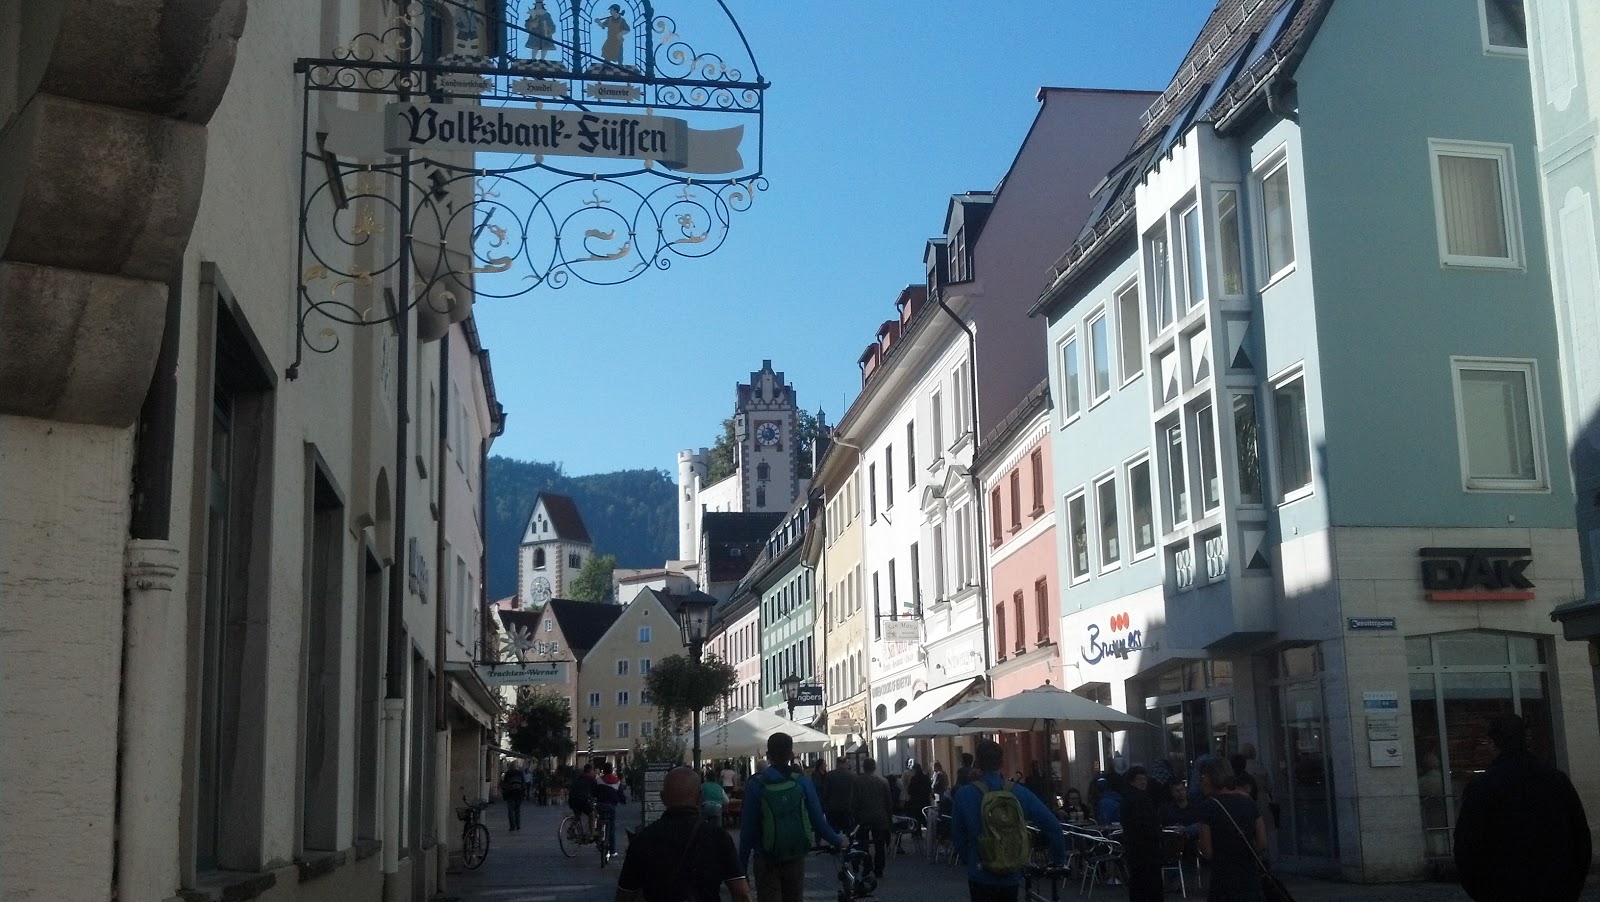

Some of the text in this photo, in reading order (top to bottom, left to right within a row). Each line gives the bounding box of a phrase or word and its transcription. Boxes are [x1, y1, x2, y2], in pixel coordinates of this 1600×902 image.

[527, 83, 553, 92] Handel
[598, 88, 629, 97] Gewerbe
[1421, 556, 1535, 590] DAK
[797, 694, 822, 702] ngbers
